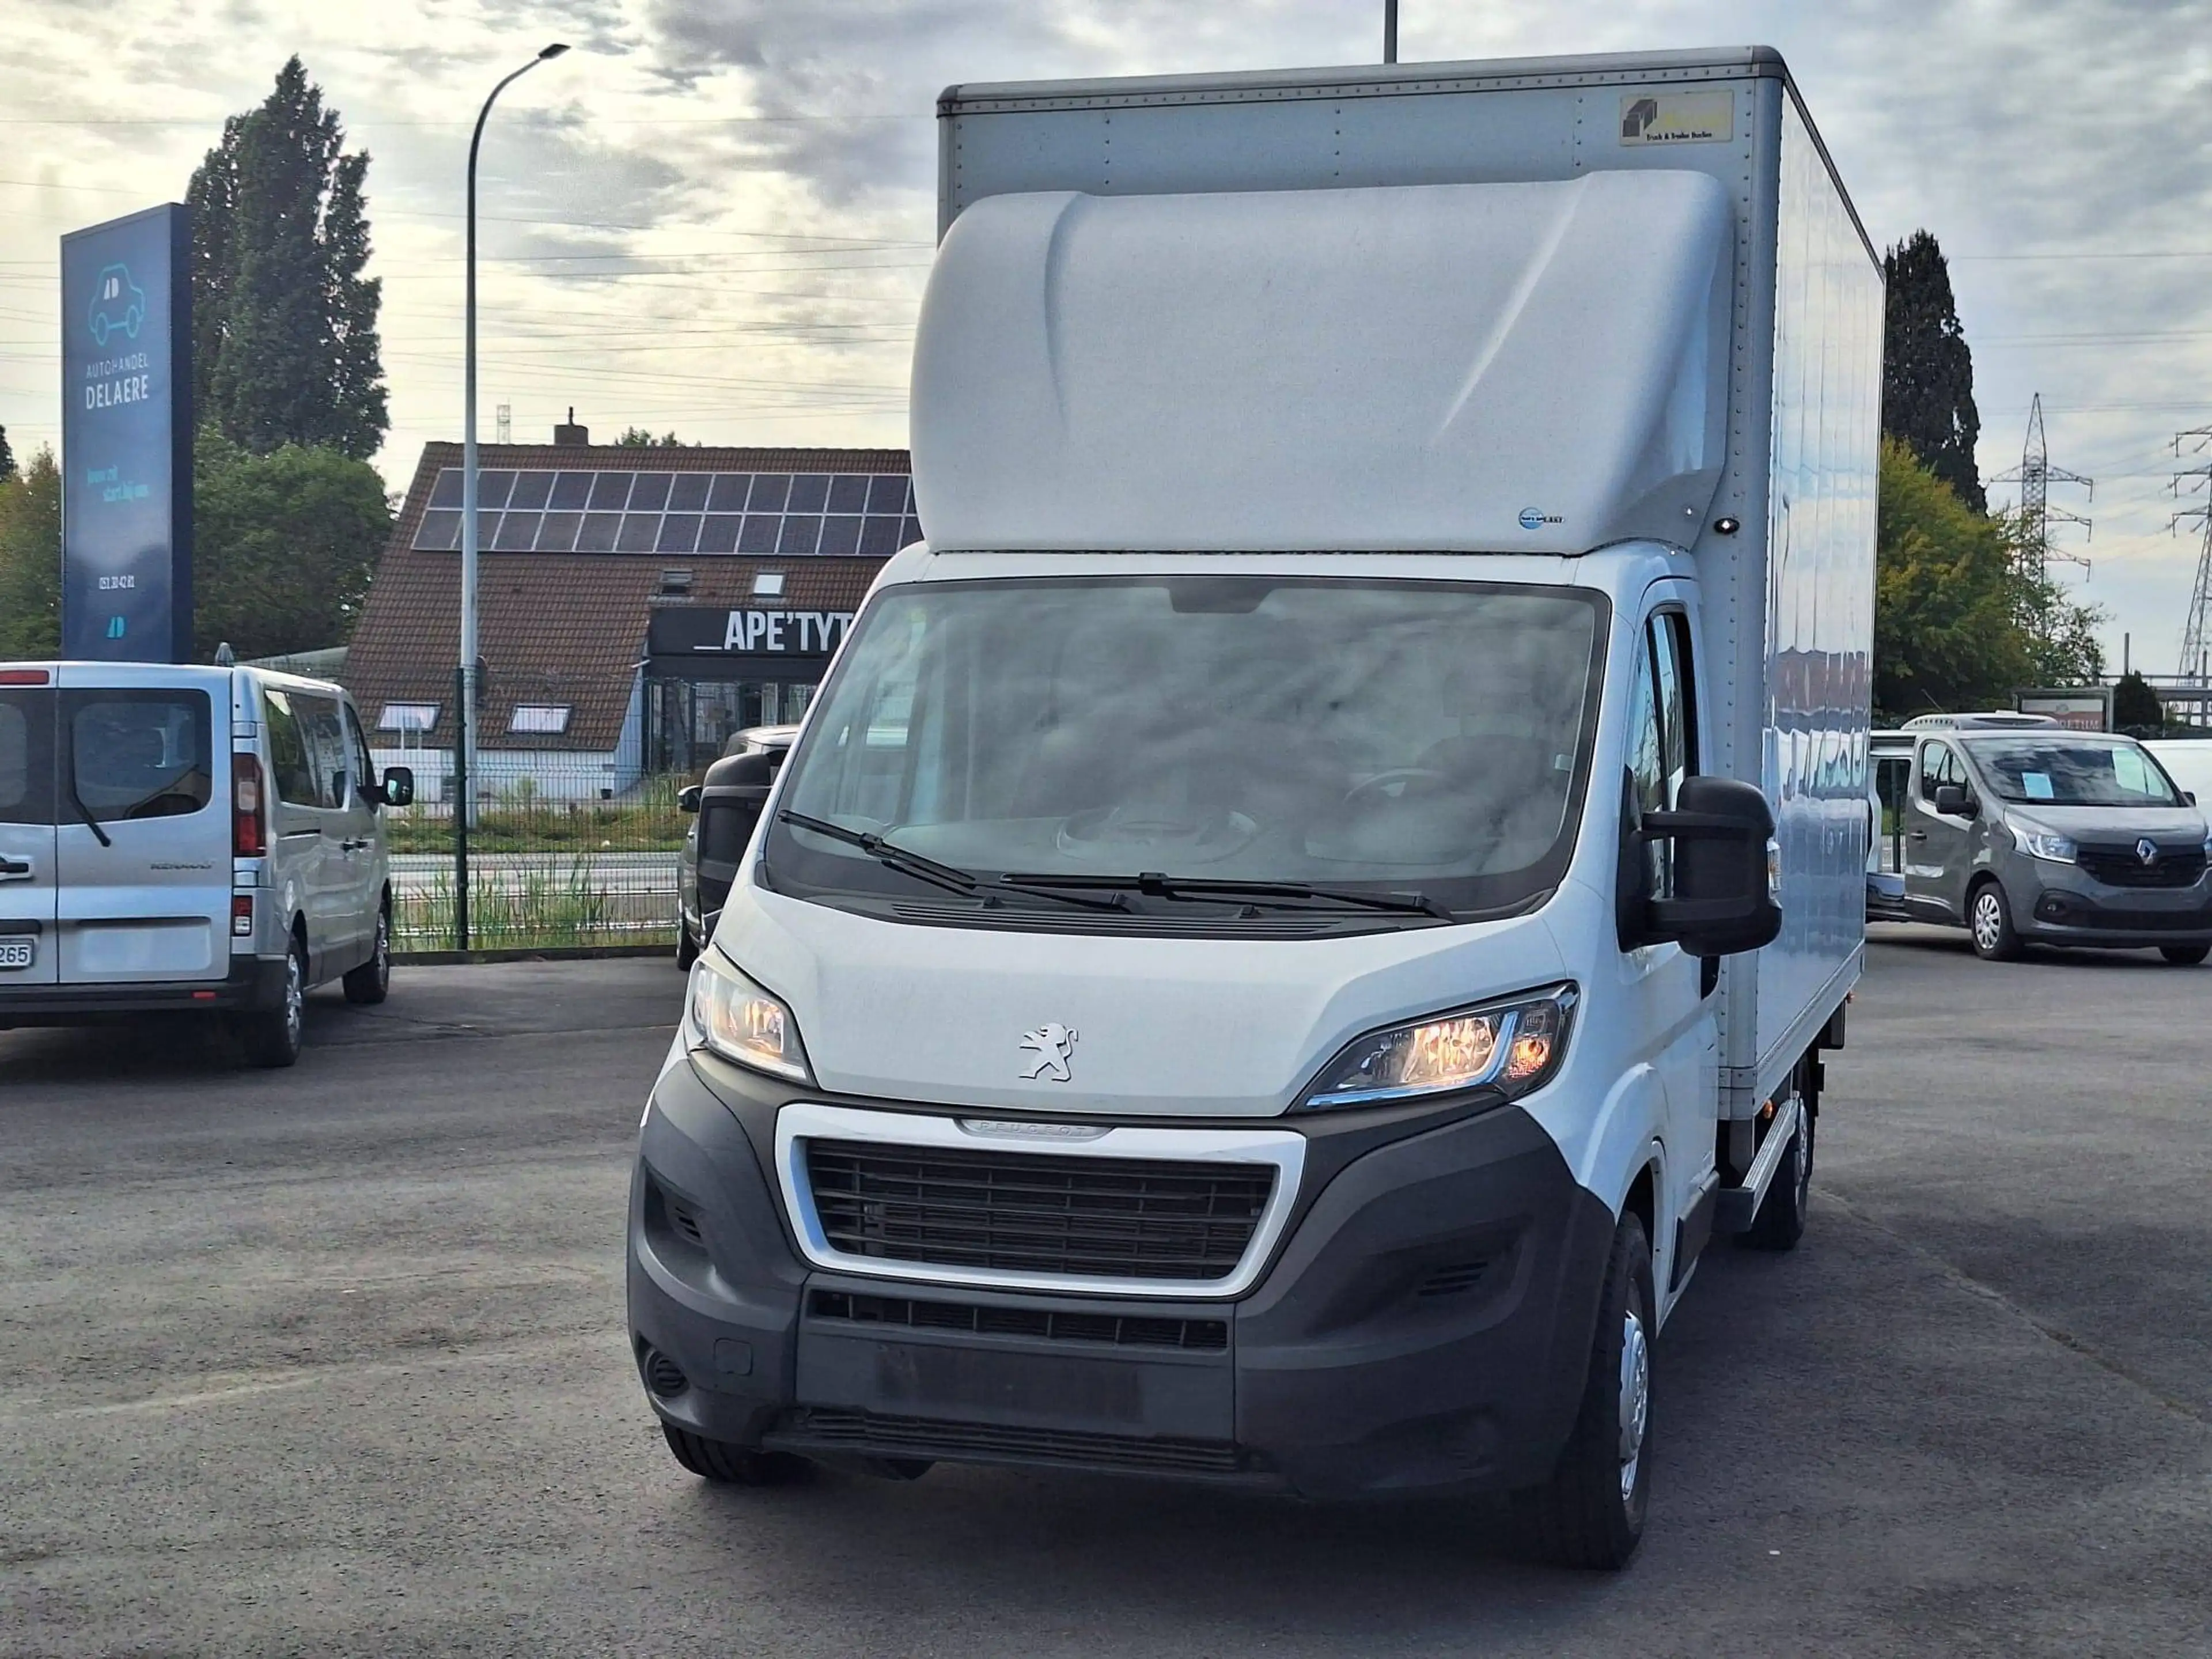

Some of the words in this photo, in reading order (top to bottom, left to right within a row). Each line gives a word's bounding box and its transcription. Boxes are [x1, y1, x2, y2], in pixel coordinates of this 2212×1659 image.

[86, 352, 148, 379] AUTOHANDEL
[86, 374, 149, 410] DELAERE
[980, 1122, 1086, 1136] PEUGEOT
